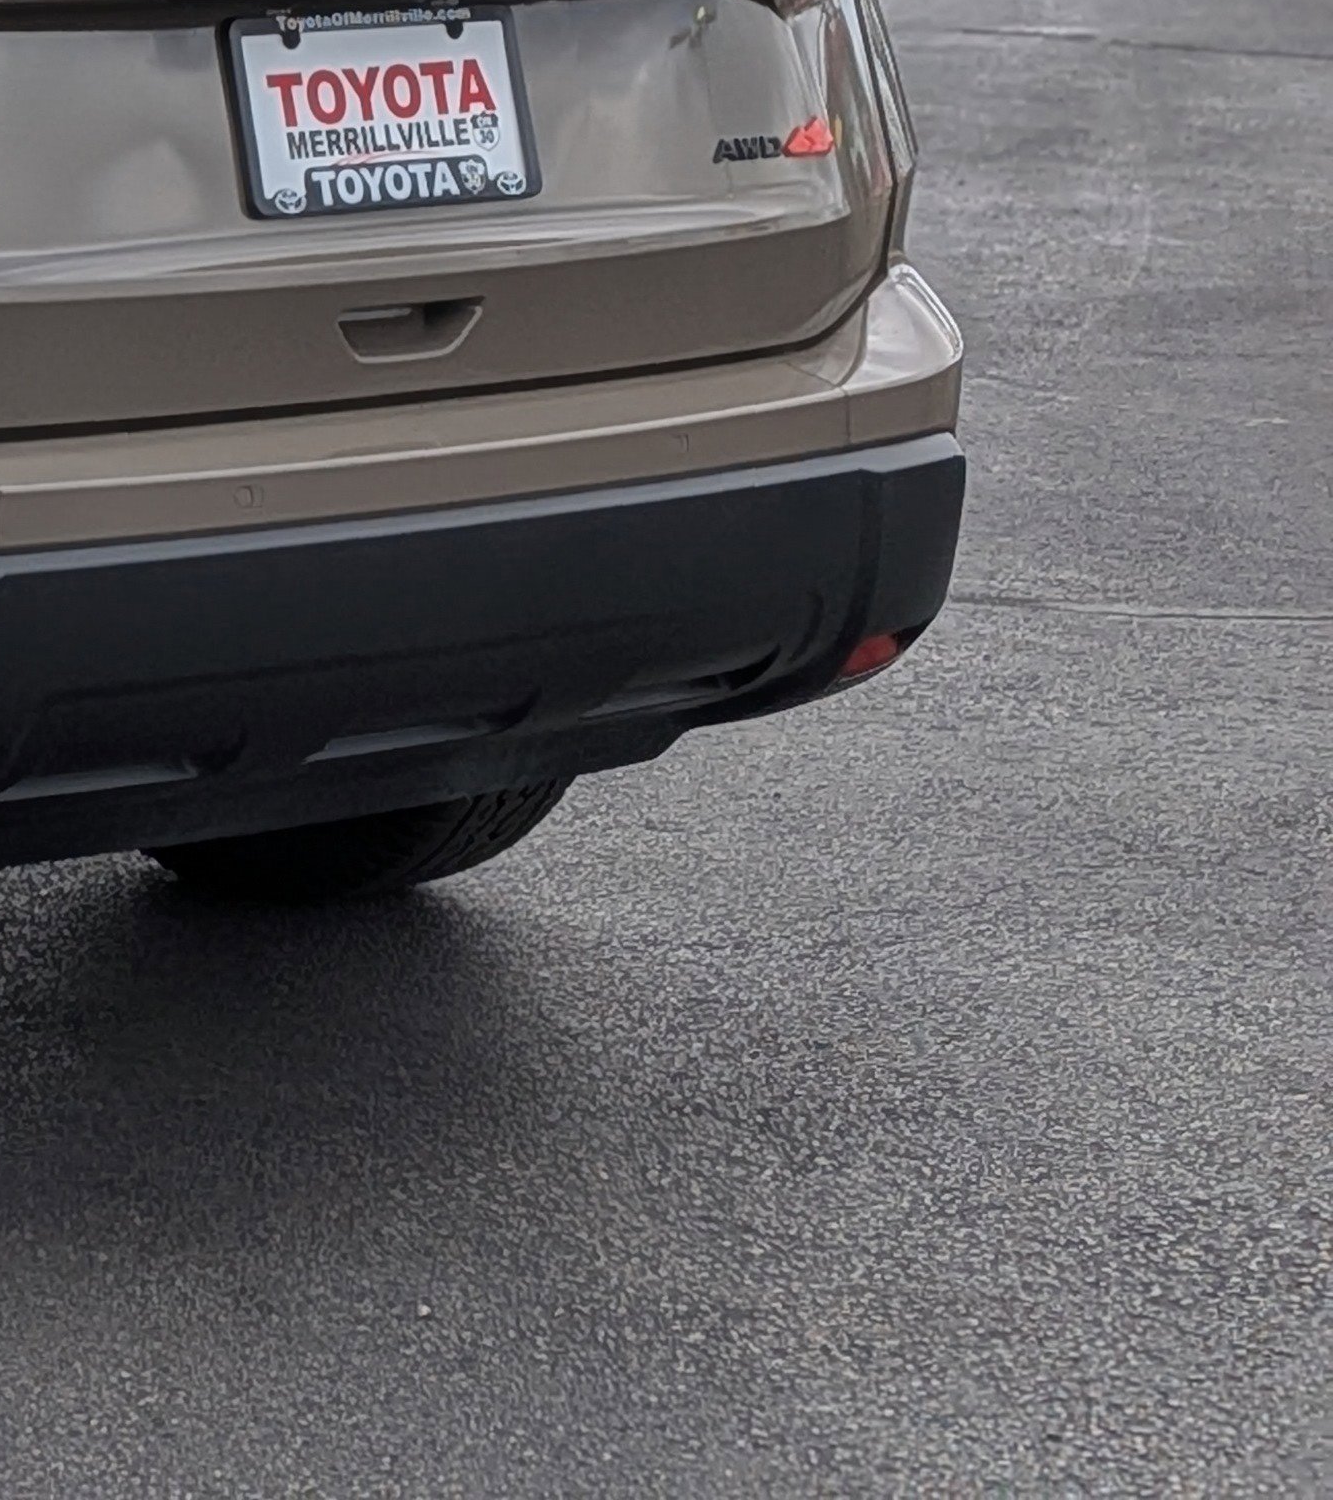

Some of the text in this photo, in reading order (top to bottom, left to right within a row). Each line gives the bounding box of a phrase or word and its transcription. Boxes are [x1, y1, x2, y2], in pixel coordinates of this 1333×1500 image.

[266, 58, 496, 128] TOYOTA
[286, 117, 471, 160] MERRILLVILLE
[712, 135, 783, 164] AWD
[311, 160, 461, 206] TOYOTA
